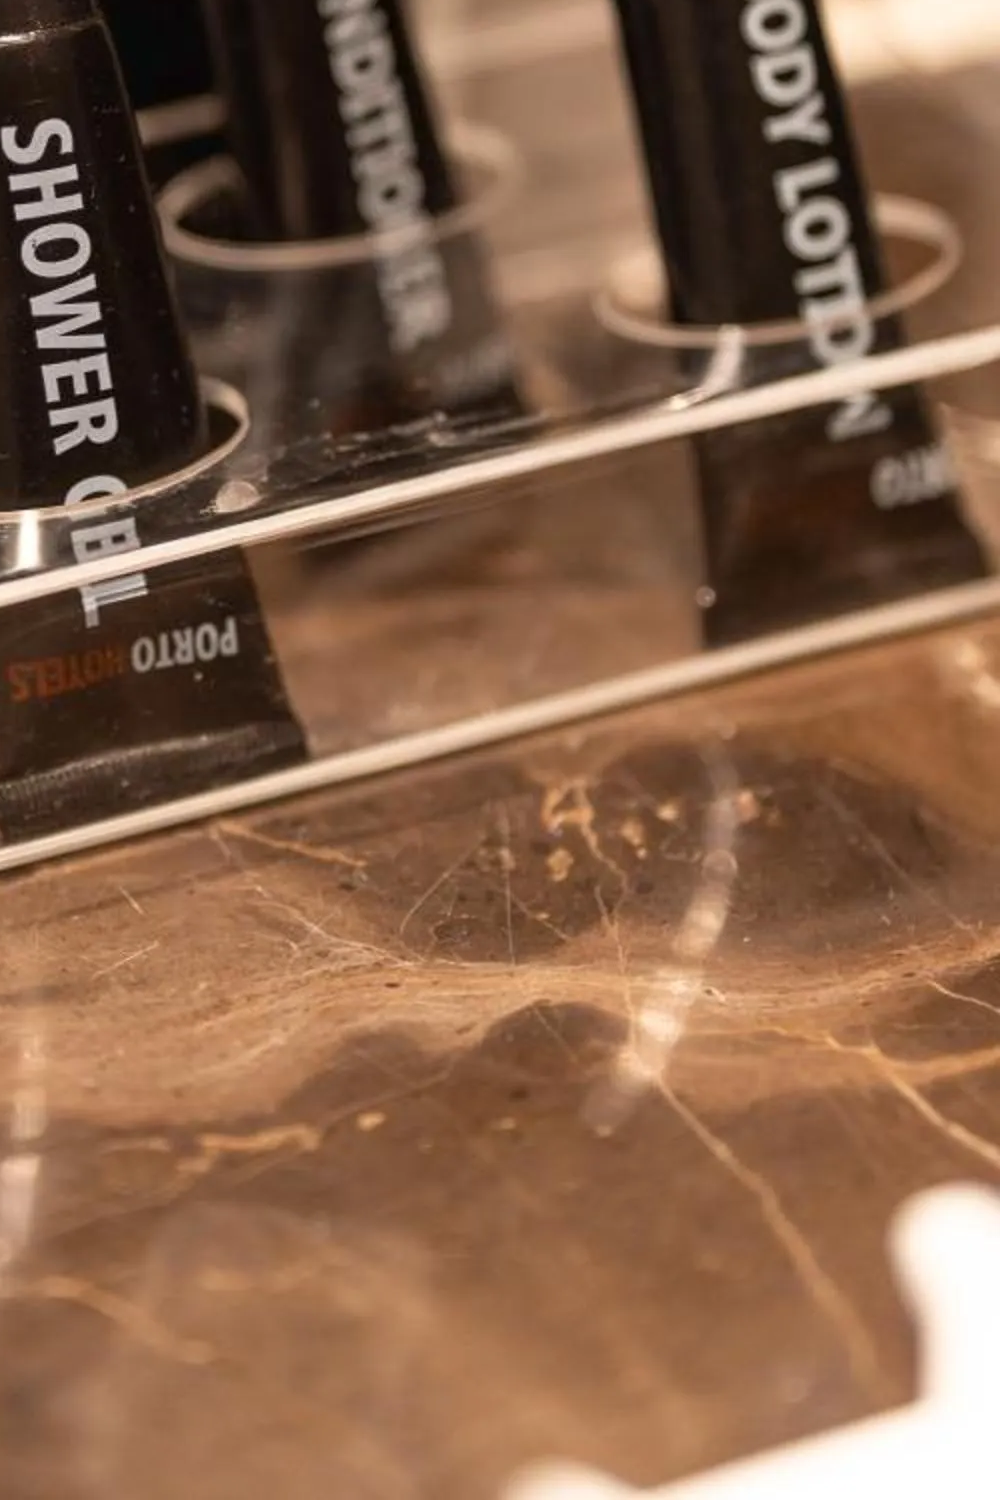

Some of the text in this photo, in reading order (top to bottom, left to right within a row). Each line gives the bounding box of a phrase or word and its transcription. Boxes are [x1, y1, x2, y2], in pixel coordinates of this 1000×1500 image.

[1, 117, 119, 456] SHOWER
[6, 617, 240, 703] PORTO HOTELS
